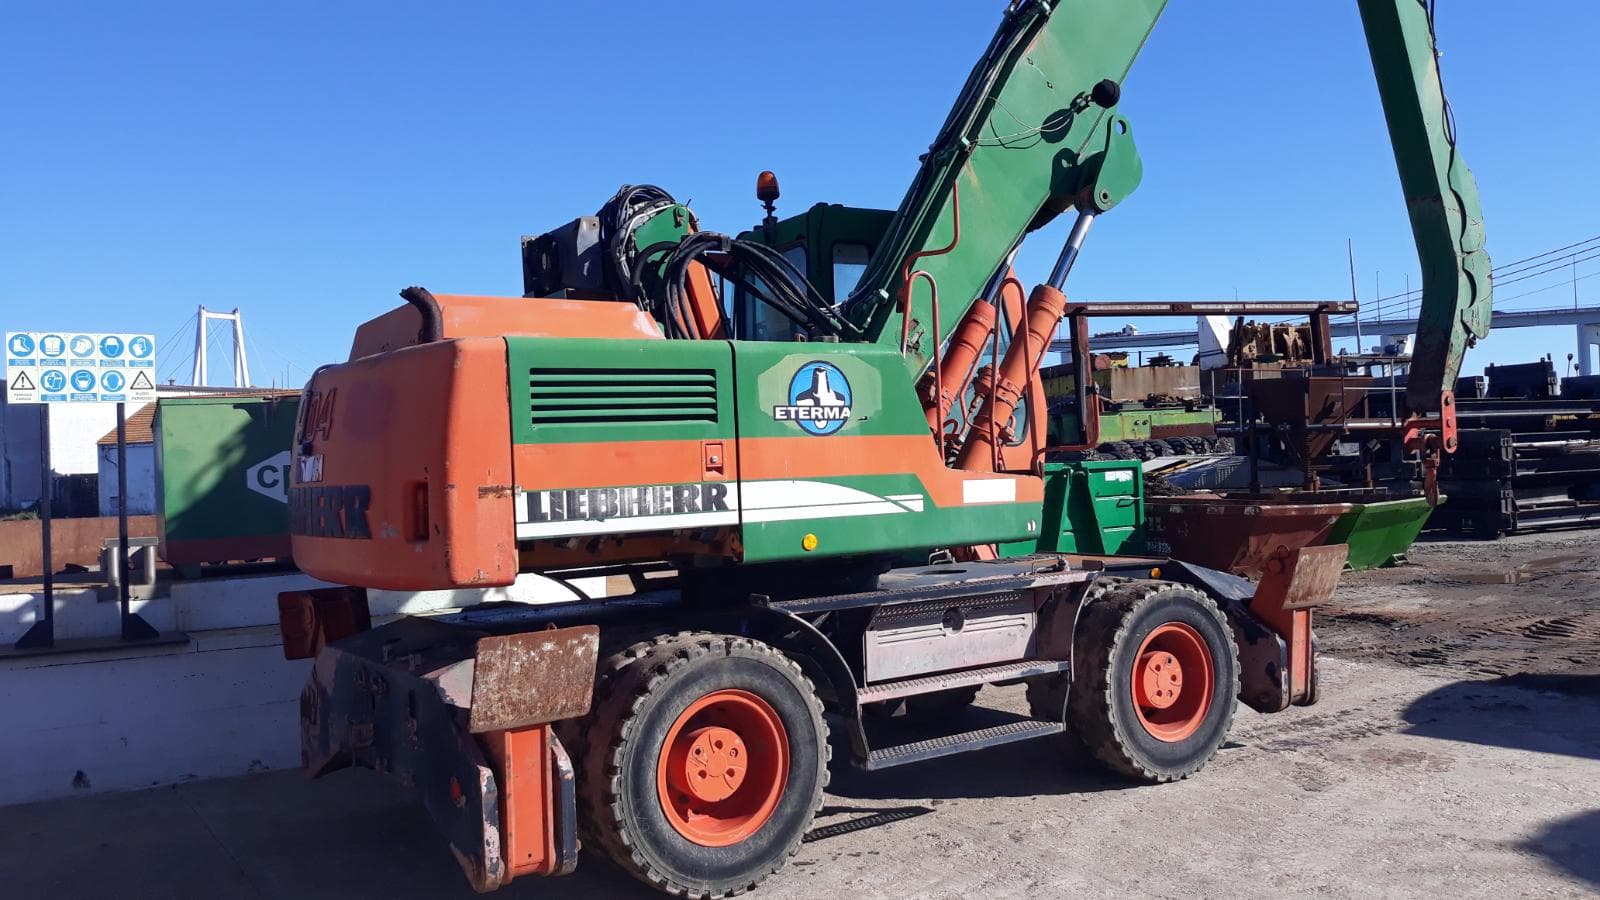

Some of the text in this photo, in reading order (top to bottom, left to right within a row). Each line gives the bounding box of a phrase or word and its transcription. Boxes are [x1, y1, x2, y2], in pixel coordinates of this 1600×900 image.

[775, 406, 851, 419] ETERMA
[257, 465, 291, 495] C
[527, 483, 729, 522] LIEBHERR
